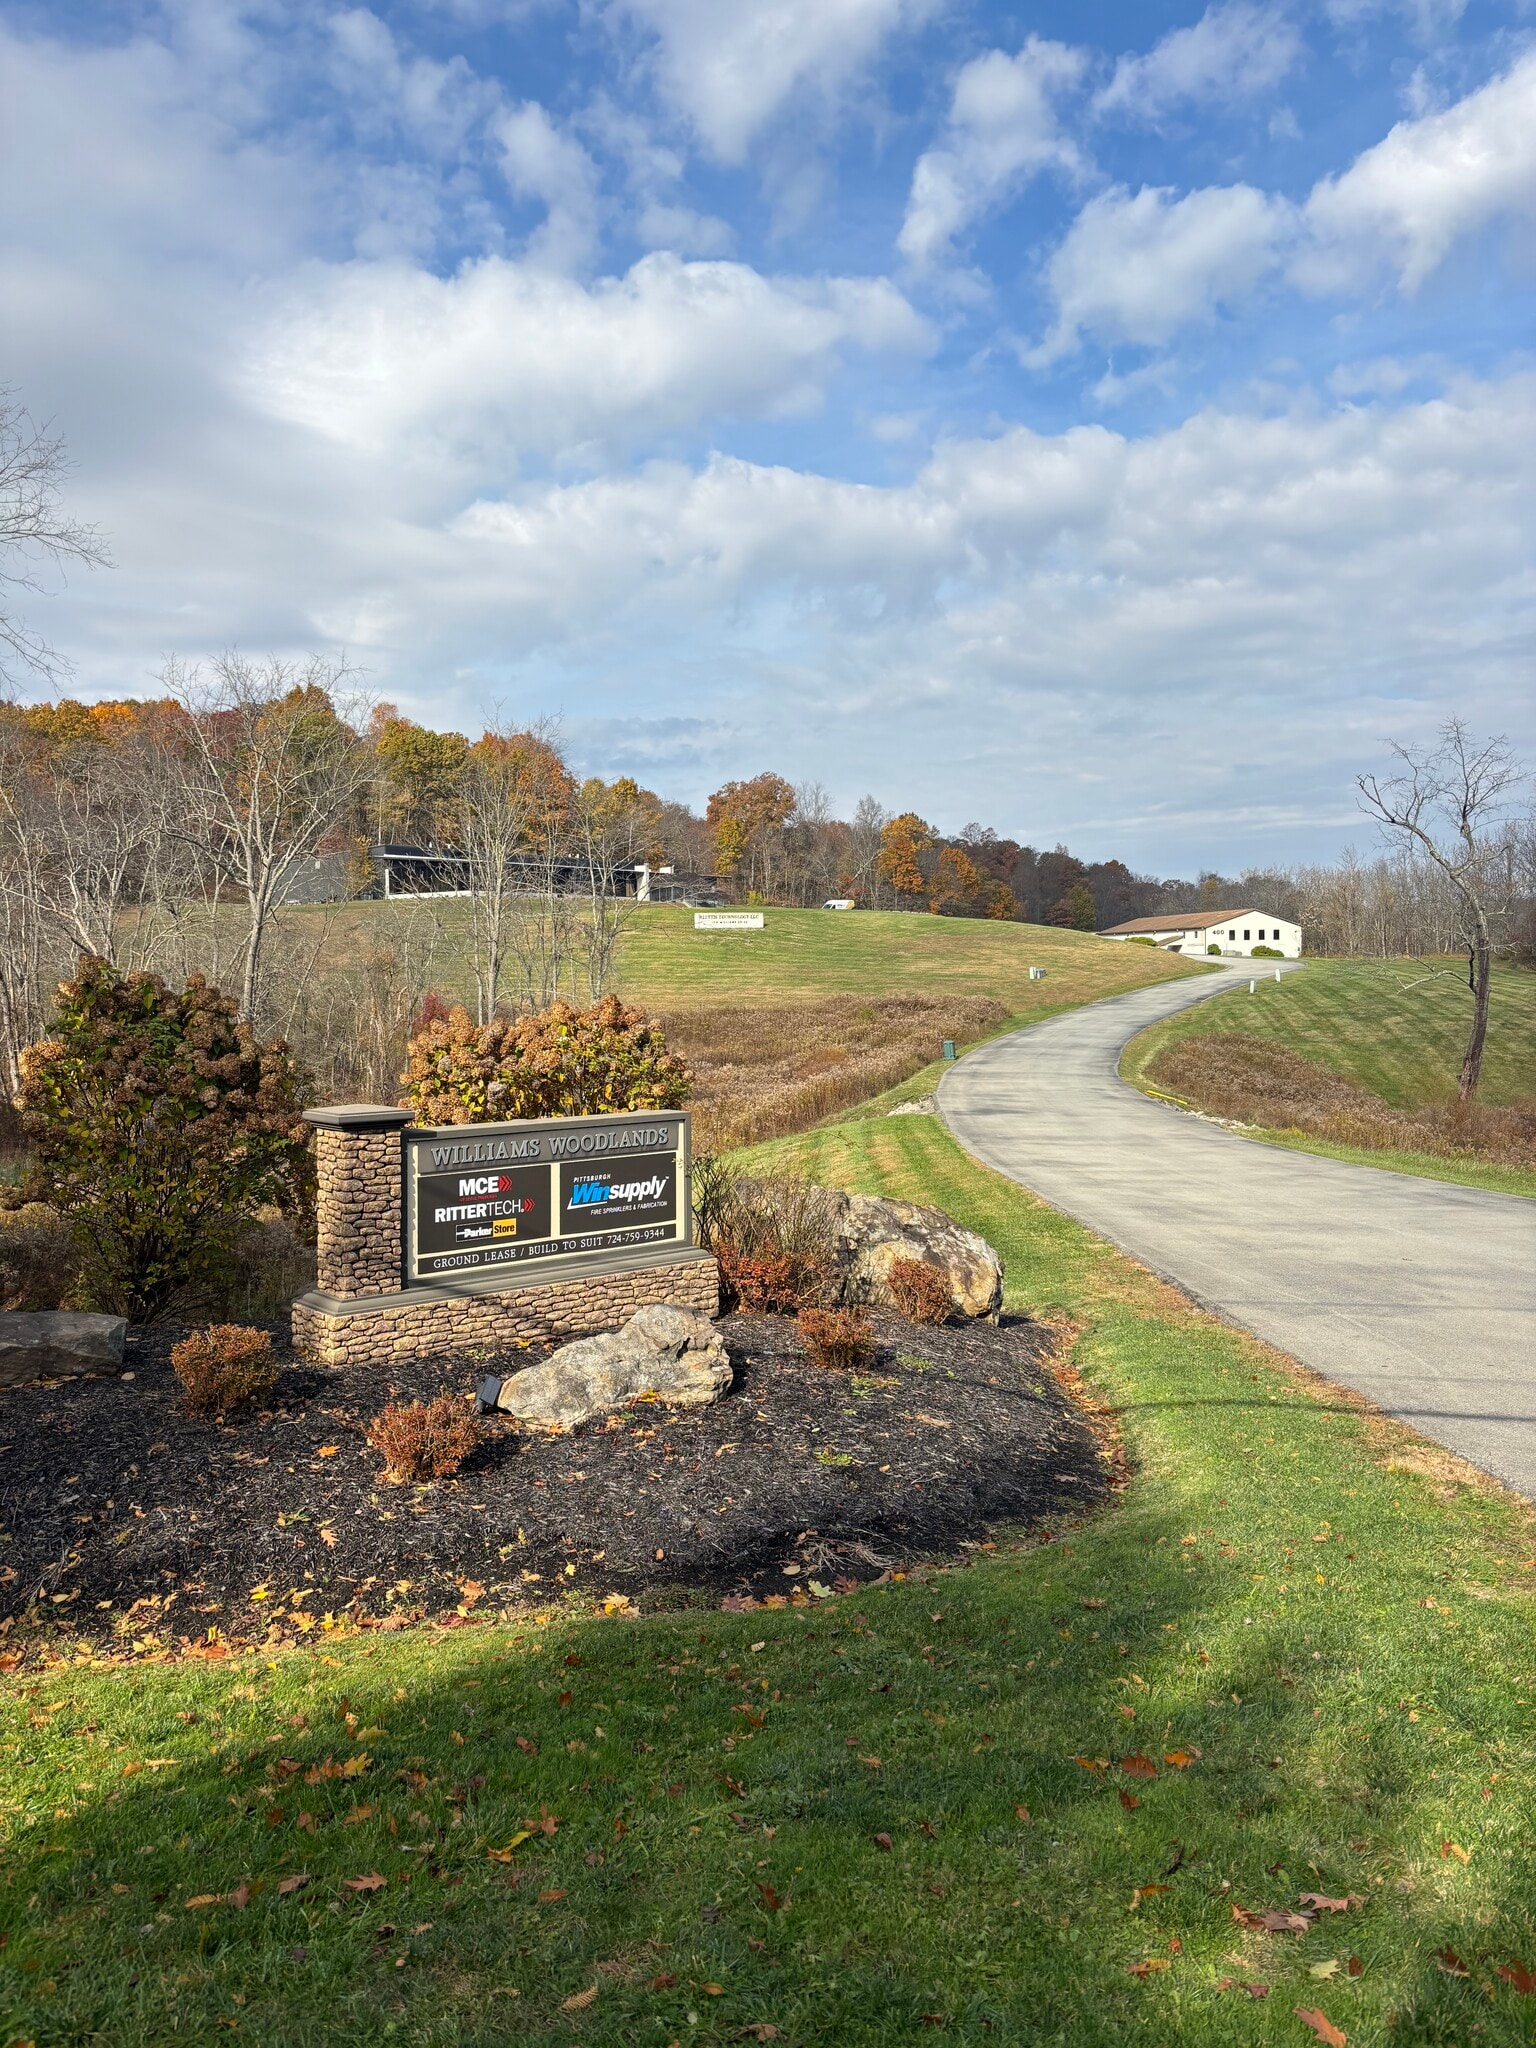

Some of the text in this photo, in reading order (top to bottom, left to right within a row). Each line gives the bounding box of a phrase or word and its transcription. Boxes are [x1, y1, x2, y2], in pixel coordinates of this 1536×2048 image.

[430, 1127, 669, 1167] WILLIAMS WOODLANDS
[459, 1175, 500, 1197] MCE
[573, 1173, 612, 1183] PITTSBURGH
[572, 1175, 667, 1204] Winsupply
[590, 1208, 602, 1216] FIRE
[602, 1204, 633, 1215] SPRINKLERS
[637, 1200, 668, 1210] FABRICATION
[463, 1223, 515, 1239] Parker Store
[433, 1227, 665, 1270] GROUND LEASE / BUILD TO SUIT 724-759-9344
